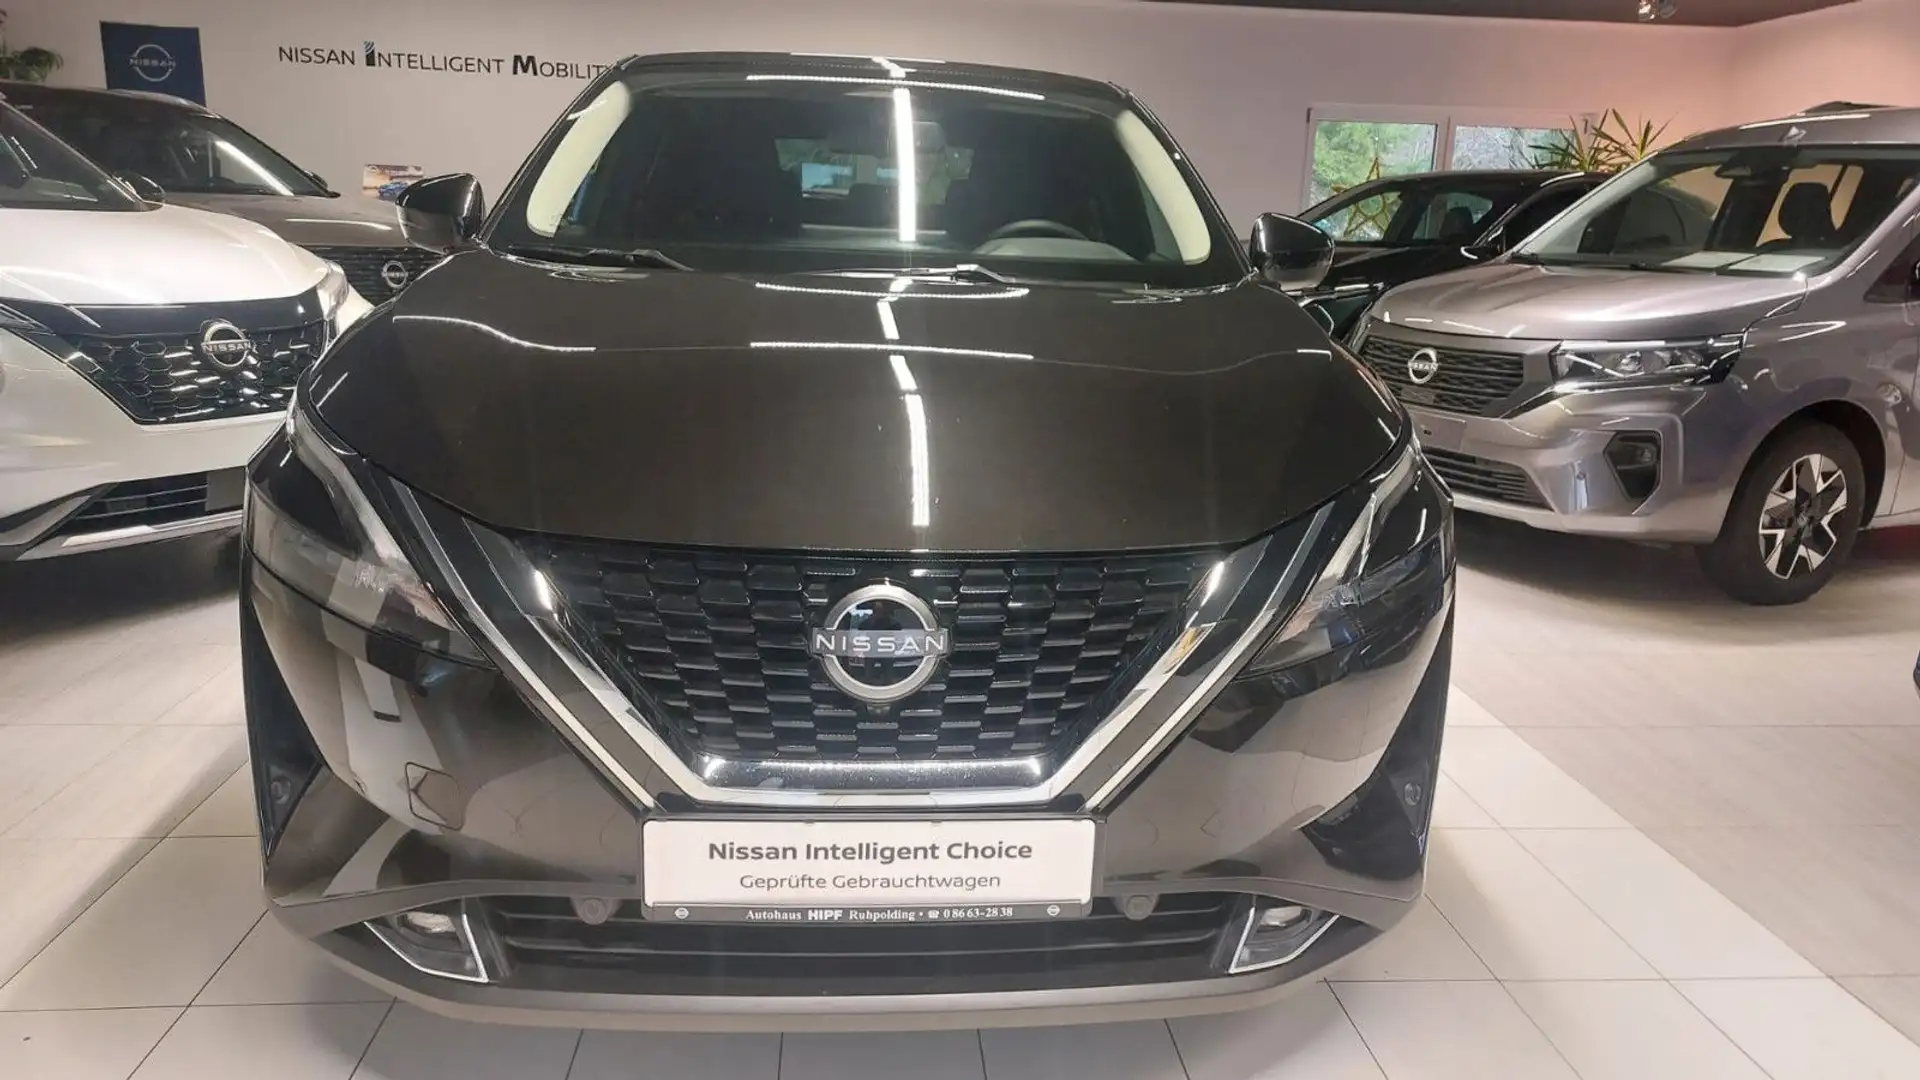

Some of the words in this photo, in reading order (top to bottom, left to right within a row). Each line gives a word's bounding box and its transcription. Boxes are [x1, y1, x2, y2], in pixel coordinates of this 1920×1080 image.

[279, 46, 356, 66] NISSAN
[364, 41, 505, 74] INTELLIGENT
[512, 54, 611, 79] MOBILIT
[202, 342, 251, 353] NISSAN
[815, 633, 944, 652] NISSAN
[709, 841, 797, 860] Nissan
[806, 841, 939, 864] Intelligent
[947, 841, 1033, 859] Choice
[739, 874, 826, 891] Geprüfte
[832, 874, 1001, 891] Gebrauchtwagen
[746, 909, 802, 920] Autohaus
[807, 909, 843, 920] HIPF
[849, 909, 916, 921] Ruhpolding
